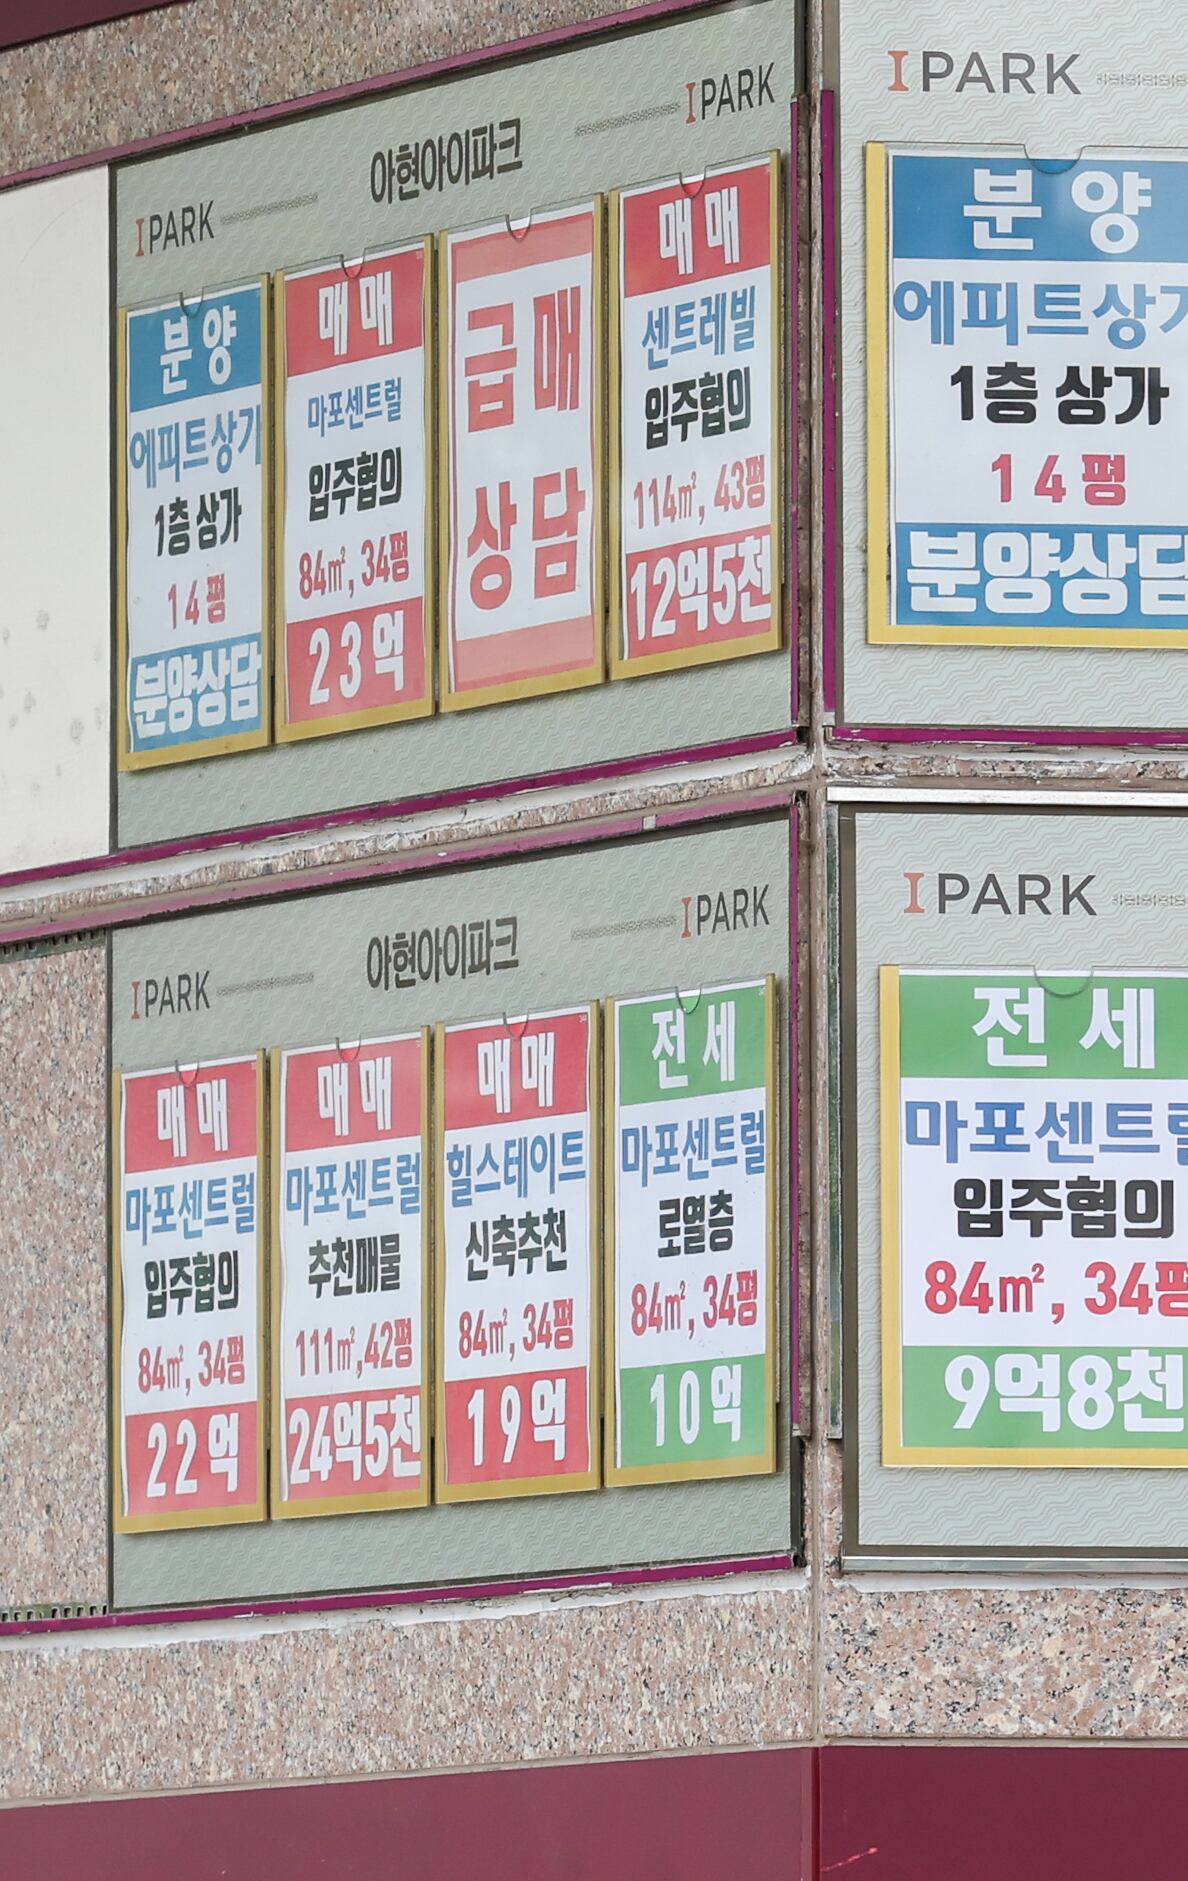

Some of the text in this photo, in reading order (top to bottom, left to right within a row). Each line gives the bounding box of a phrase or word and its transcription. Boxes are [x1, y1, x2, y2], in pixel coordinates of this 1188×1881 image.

[370, 117, 523, 205] 아현아이파크
[641, 285, 756, 371] 센트레빌
[307, 376, 402, 438] 마포센트럴
[644, 366, 751, 450] 입주협의
[950, 361, 1170, 426] 1층 상가
[129, 404, 262, 489] 에피트상가
[308, 446, 402, 522] 입주협의
[154, 486, 243, 557] 1층 상가
[630, 543, 773, 641] 12억5천
[133, 641, 264, 739] 분양상담
[366, 916, 520, 992] 아현아이파크
[446, 1130, 587, 1208] 힐스테이트
[621, 1109, 765, 1188] 마포센트럴
[125, 1172, 255, 1246] 마포센트럴
[285, 1151, 421, 1226] 마포센트럴
[657, 1189, 734, 1258] 로열층
[953, 1175, 1175, 1239] 입주협의
[308, 1233, 401, 1299] 추천매물
[465, 1207, 568, 1282] 신축추천
[144, 1249, 239, 1320] 입주협의
[944, 1348, 1185, 1433] 9억8천
[288, 1393, 422, 1485] 24억5천
